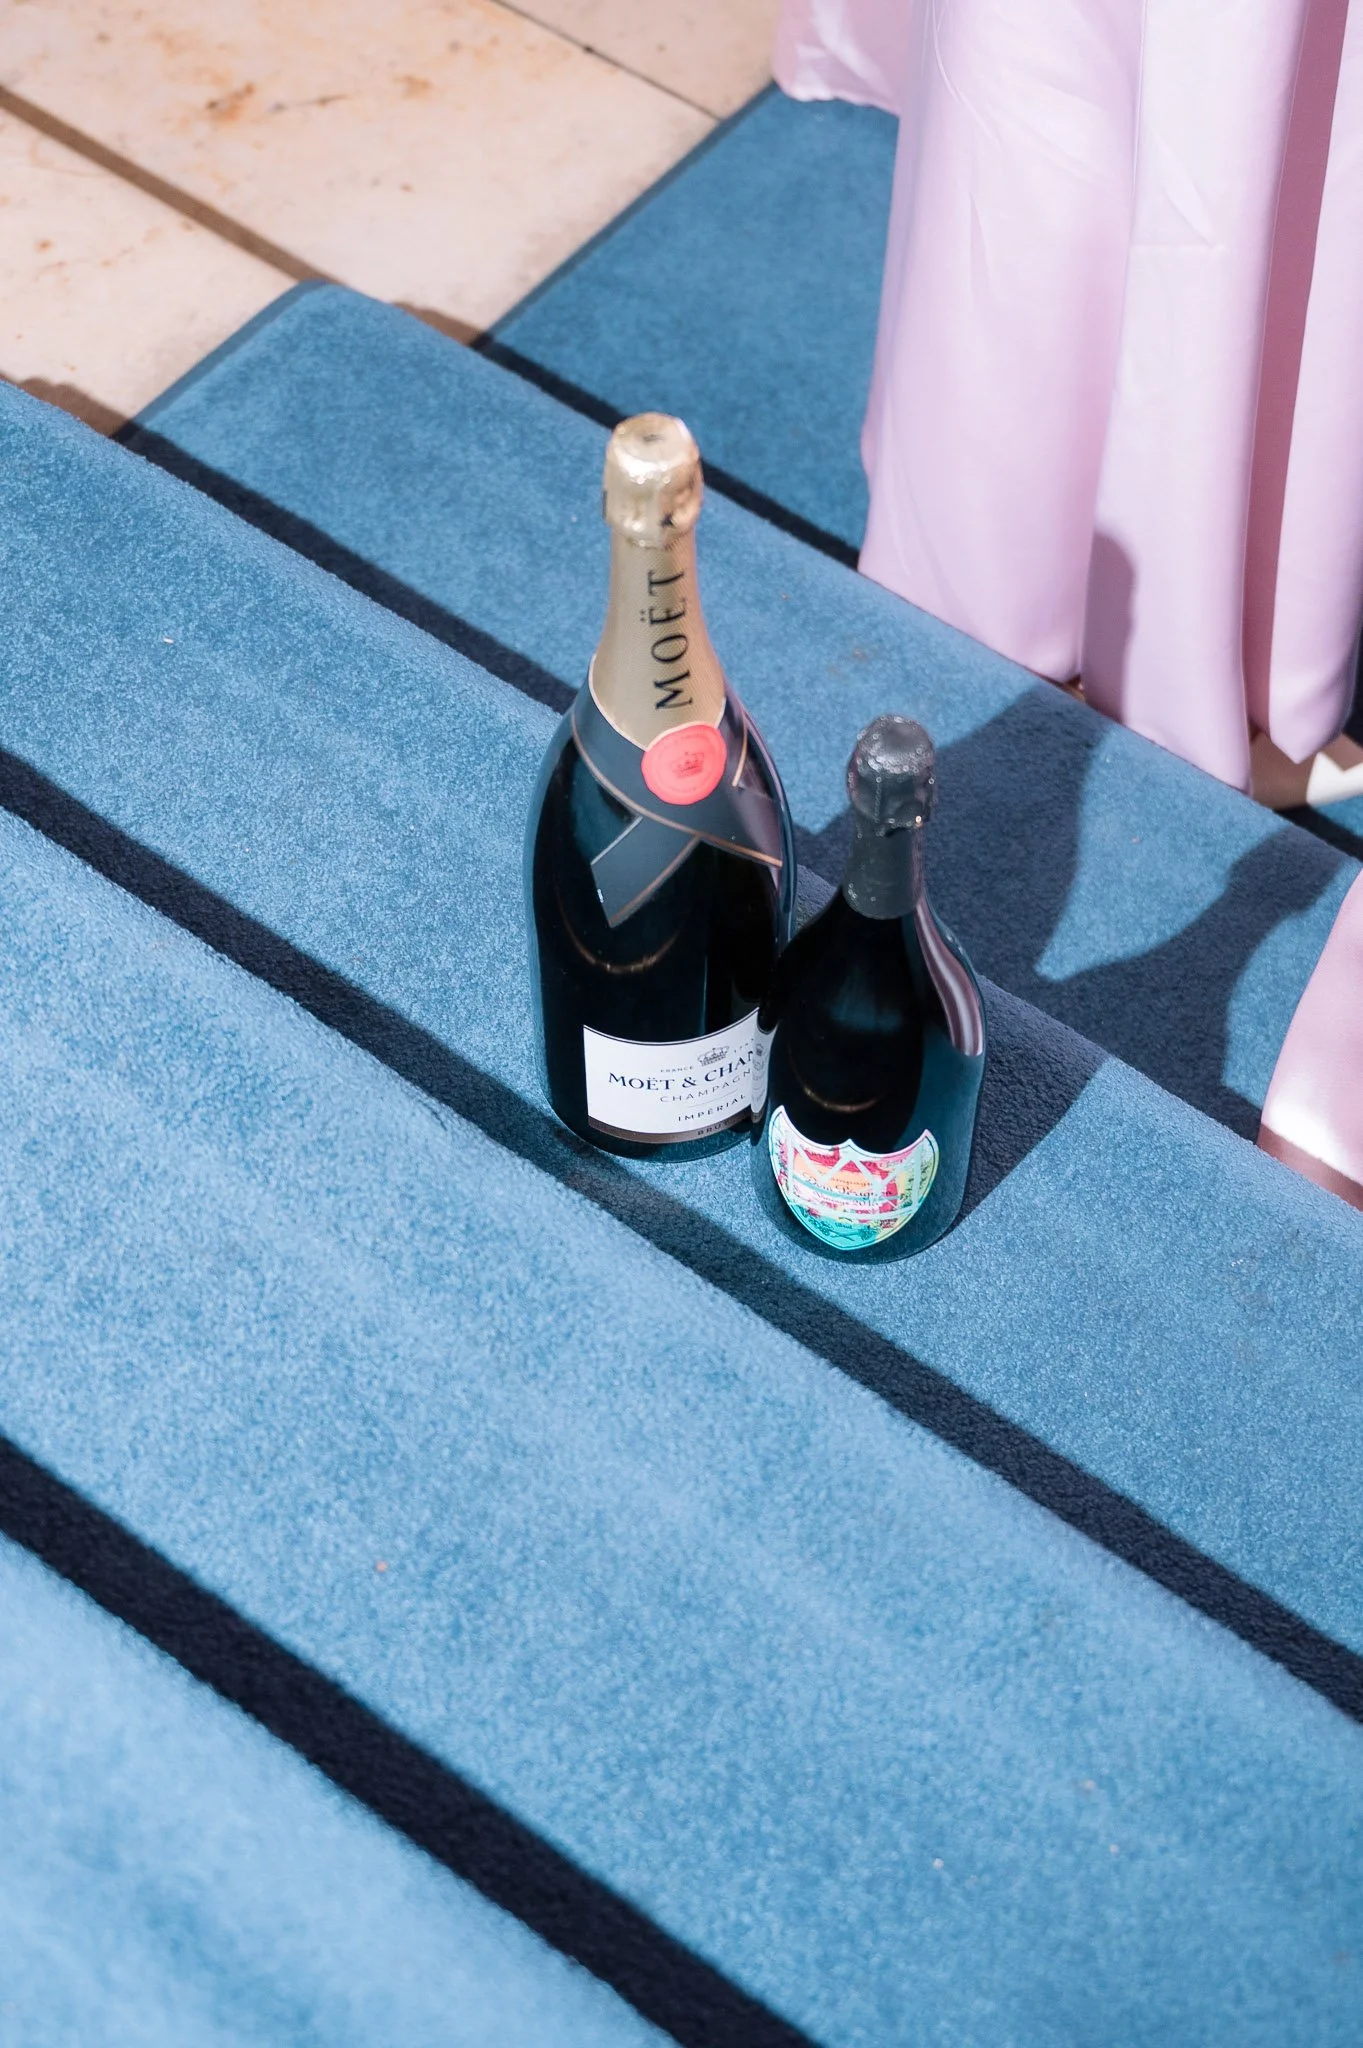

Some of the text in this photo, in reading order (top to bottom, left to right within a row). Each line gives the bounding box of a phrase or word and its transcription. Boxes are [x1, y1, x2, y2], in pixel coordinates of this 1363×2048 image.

[640, 570, 693, 710] MOËT
[660, 1065, 694, 1073] FRANCE
[608, 1072, 675, 1091] MOËT
[681, 1076, 697, 1089] &
[677, 1093, 747, 1122] IMPÉRIAL
[696, 1121, 731, 1136] BRUT
